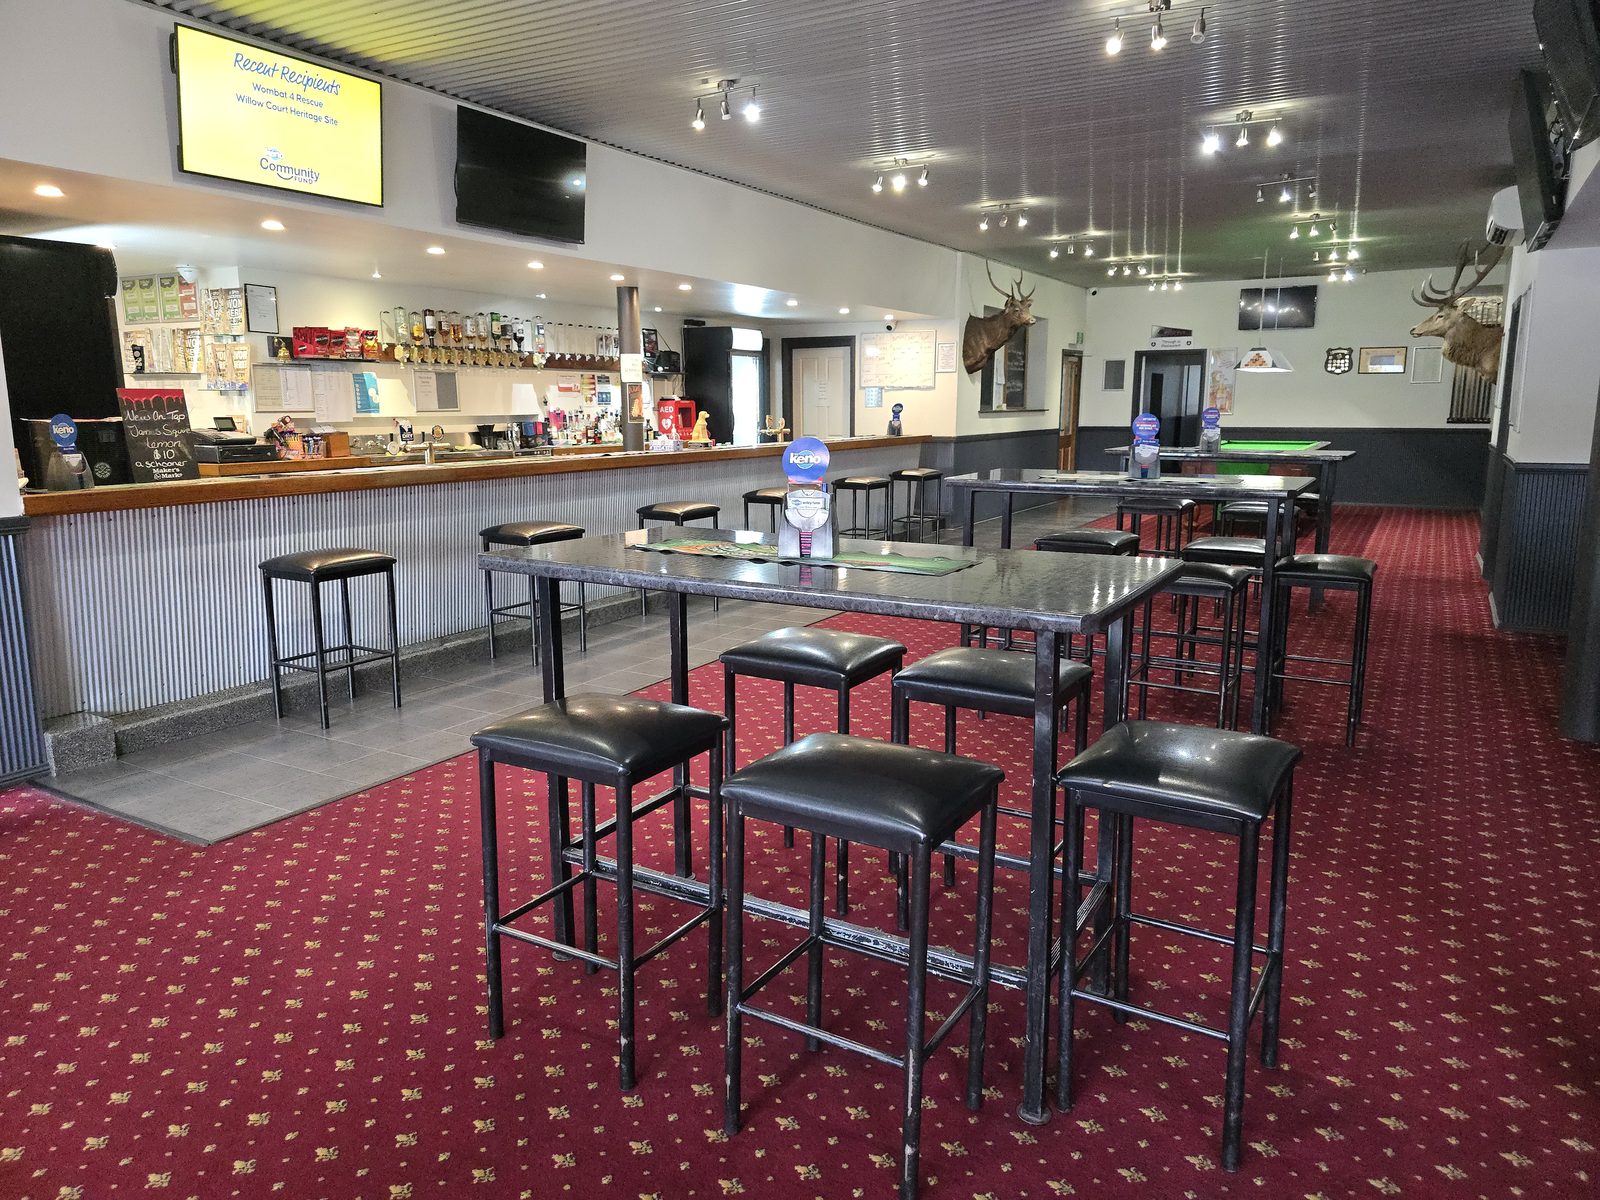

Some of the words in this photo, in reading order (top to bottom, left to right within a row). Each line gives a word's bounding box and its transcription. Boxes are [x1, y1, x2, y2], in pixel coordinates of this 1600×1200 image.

[233, 52, 279, 78] Recent
[280, 65, 341, 96] Recipients
[252, 82, 288, 99] Wombat
[289, 92, 295, 100] 4
[296, 94, 324, 108] Rescue
[236, 93, 264, 108] Willow
[265, 101, 289, 114] Court
[289, 106, 323, 123] Heritage
[324, 115, 338, 126] Site
[260, 157, 320, 182] Community
[294, 176, 313, 184] FUND
[125, 409, 151, 422] New
[152, 410, 166, 421] On
[659, 405, 674, 413] AED
[53, 424, 75, 434] keno
[789, 452, 822, 464] keno
